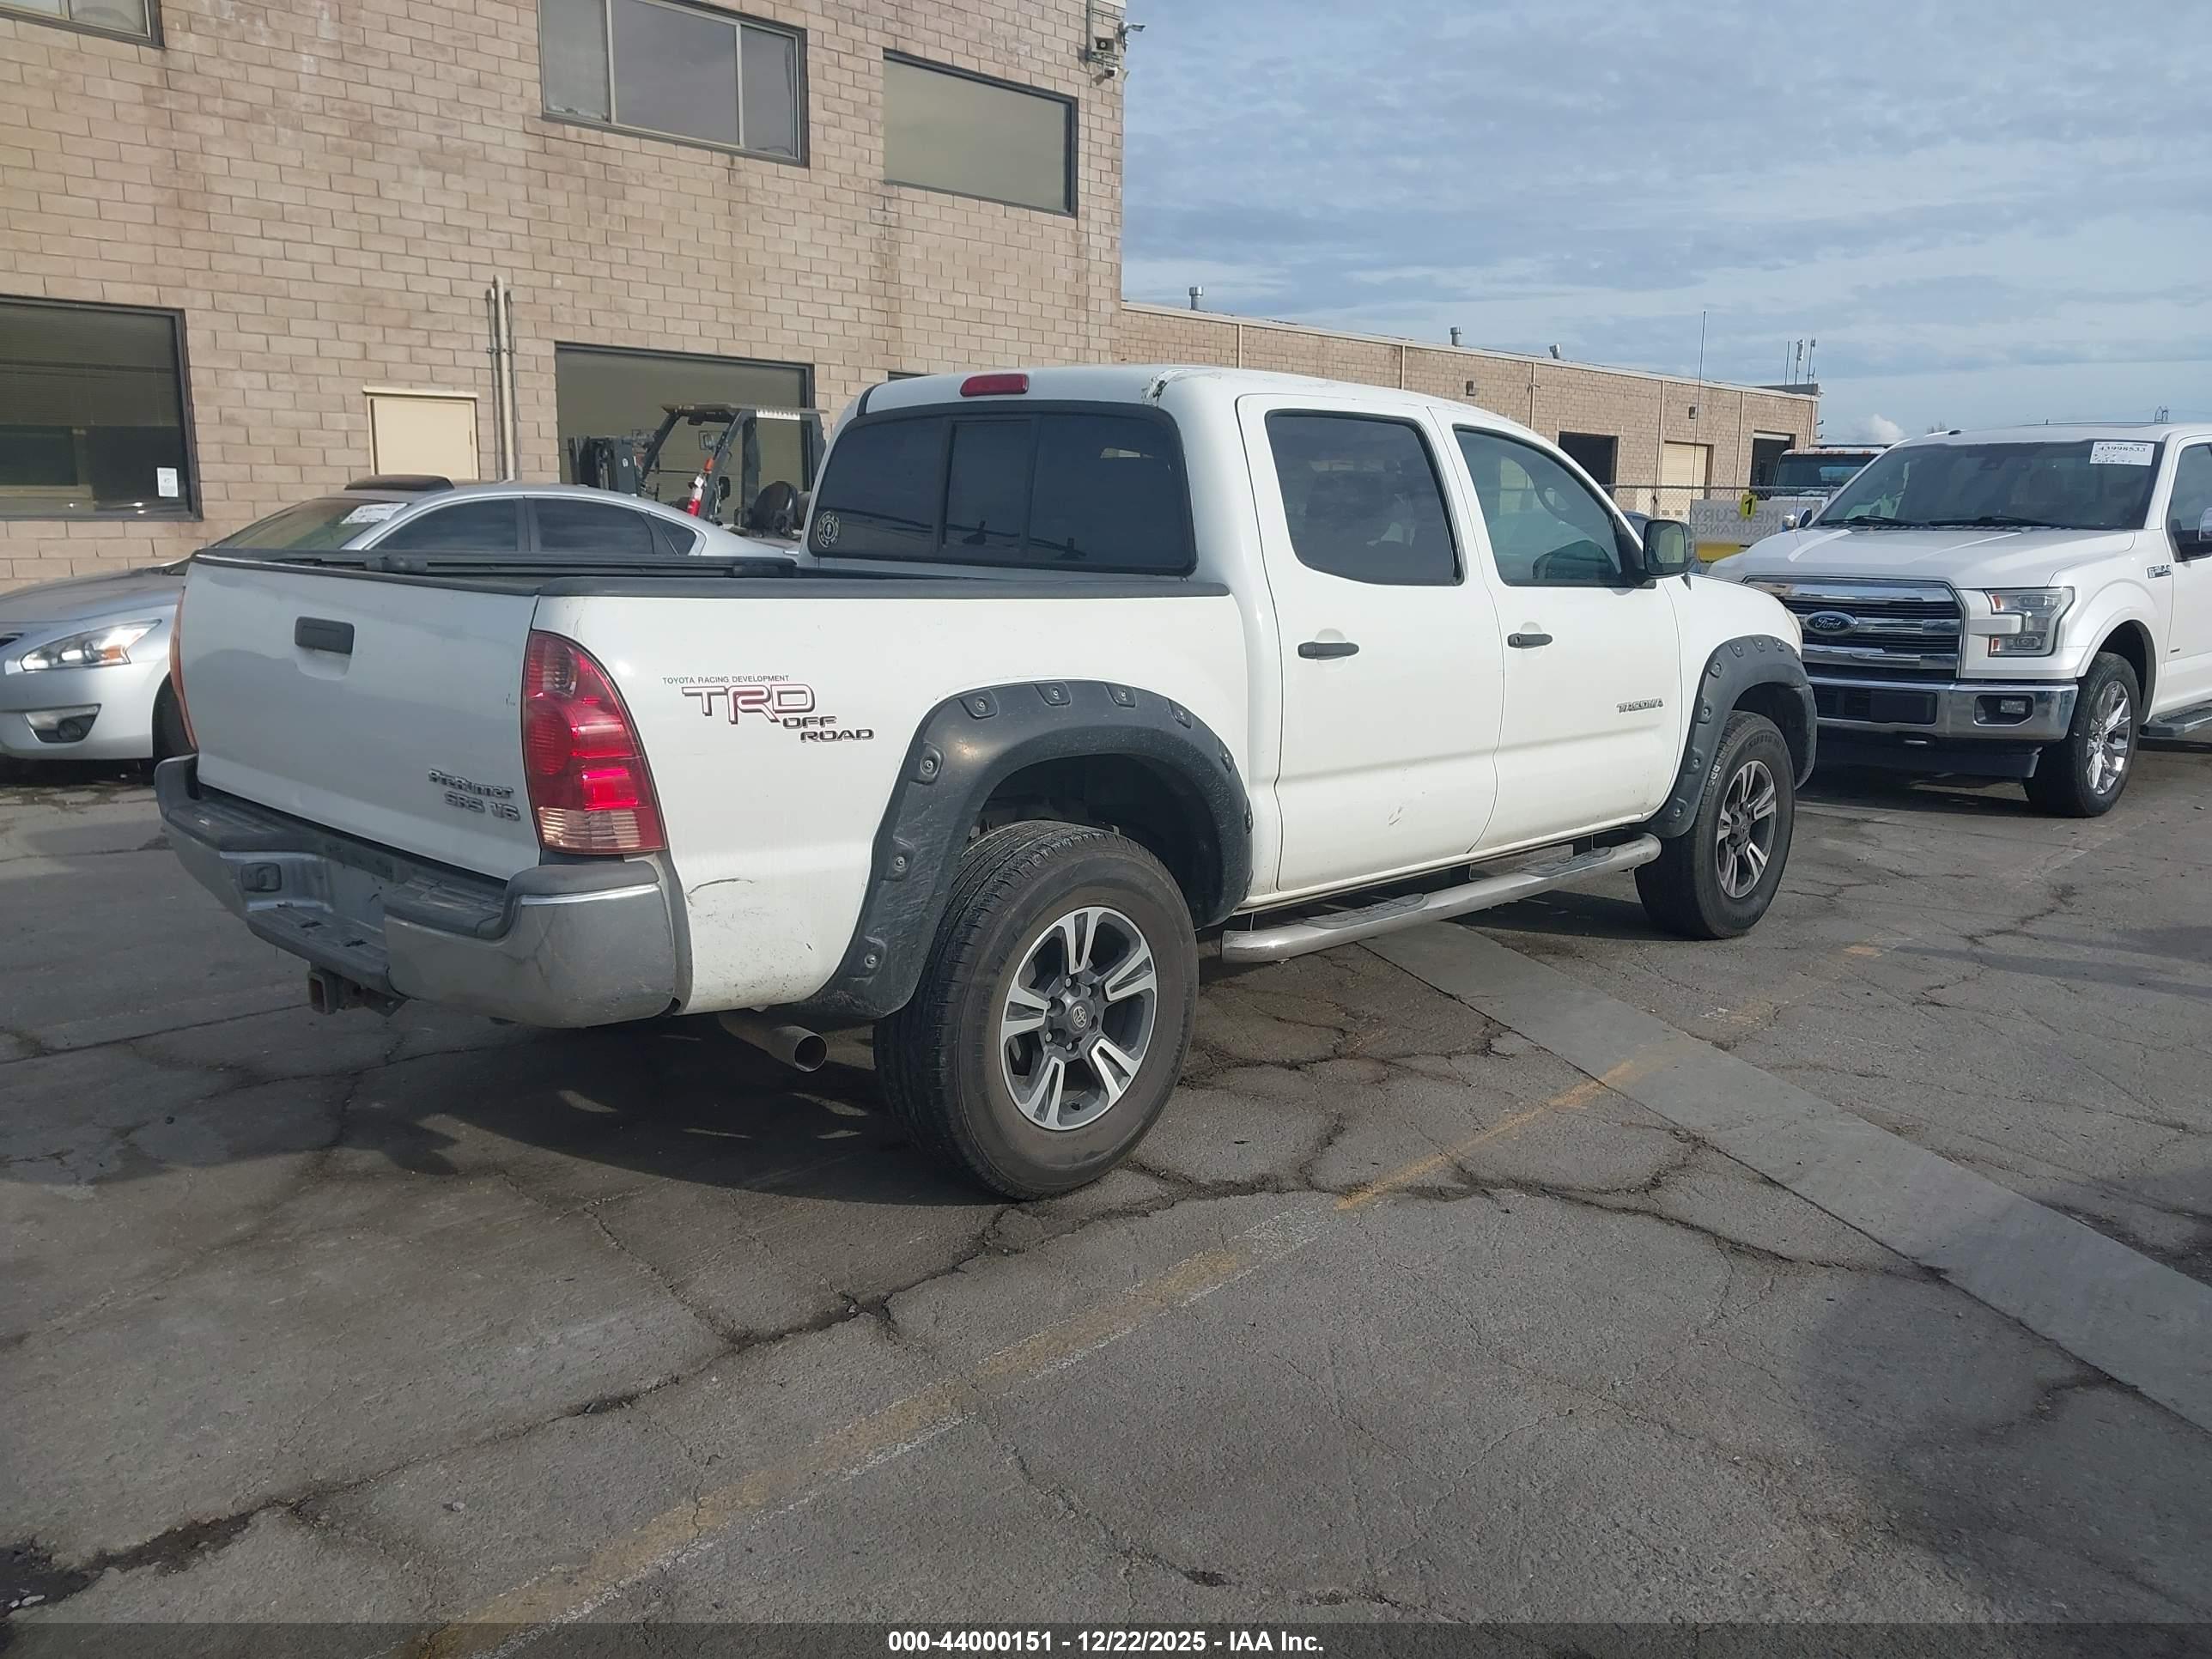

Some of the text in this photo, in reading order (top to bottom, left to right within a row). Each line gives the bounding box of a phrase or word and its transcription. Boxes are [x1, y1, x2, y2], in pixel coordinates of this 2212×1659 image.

[1744, 497, 1753, 515] 1
[1814, 617, 1842, 629] Ford
[682, 684, 815, 724] TRD
[782, 716, 837, 729] OFF
[800, 729, 874, 743] ROAD
[489, 801, 521, 822] V6
